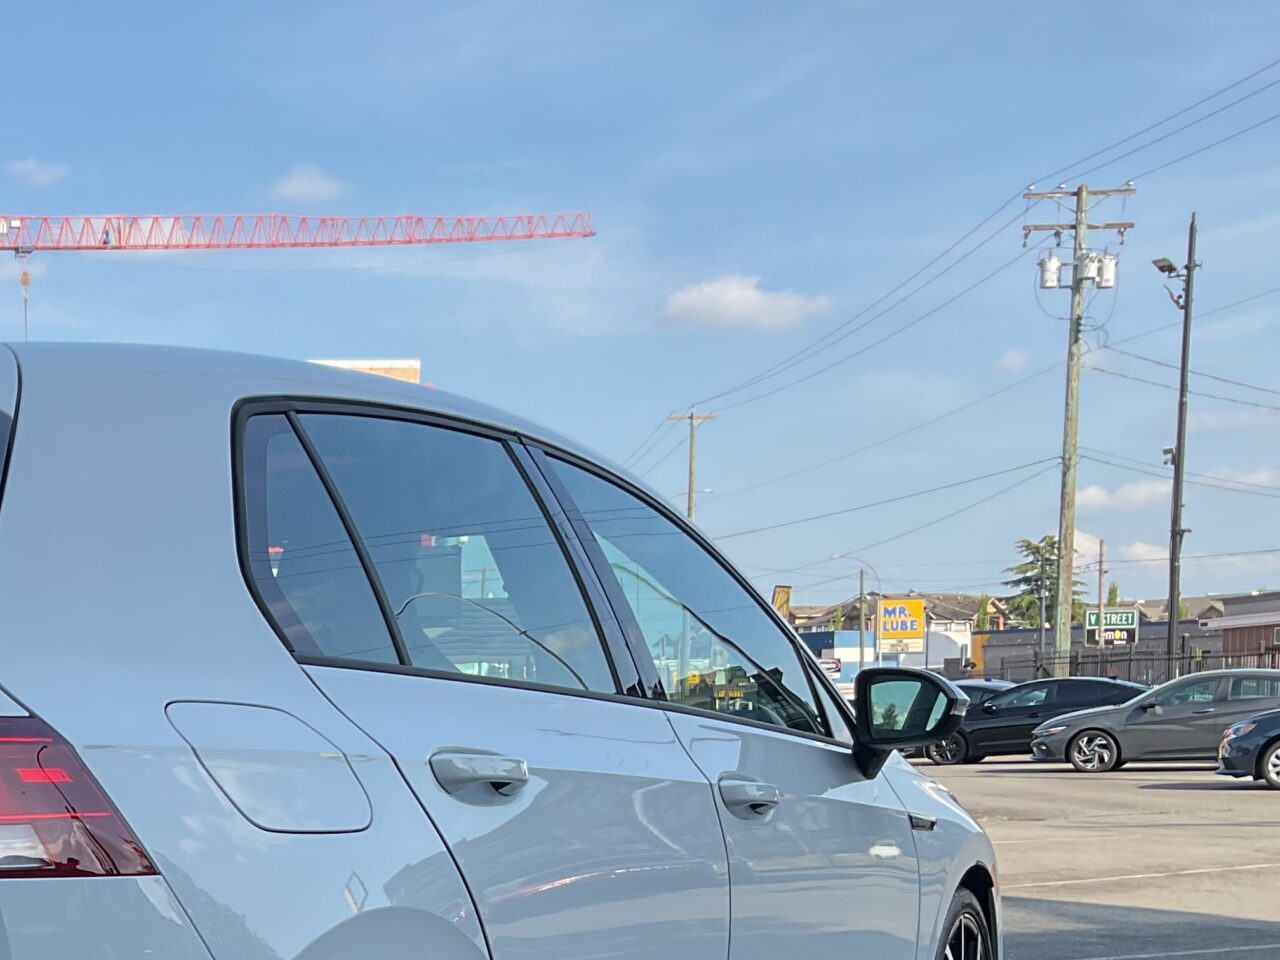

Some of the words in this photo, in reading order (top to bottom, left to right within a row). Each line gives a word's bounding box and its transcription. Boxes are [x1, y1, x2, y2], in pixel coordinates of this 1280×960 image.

[883, 606, 912, 618] MR.
[1090, 614, 1097, 625] V
[883, 620, 918, 632] LUBE
[1095, 629, 1128, 641] Lmon
